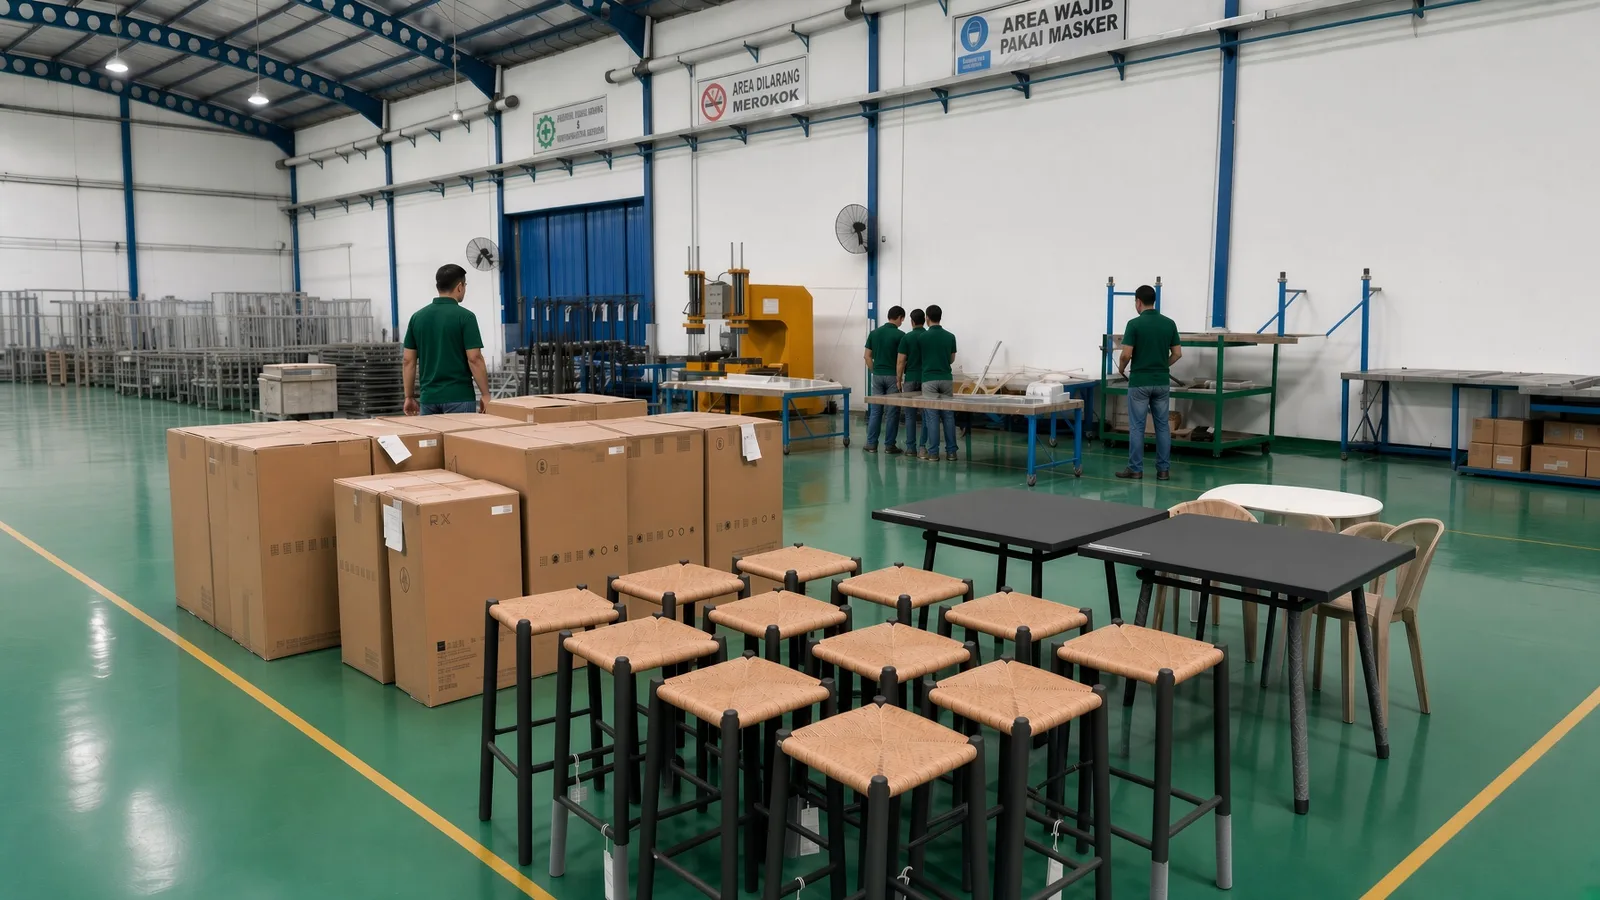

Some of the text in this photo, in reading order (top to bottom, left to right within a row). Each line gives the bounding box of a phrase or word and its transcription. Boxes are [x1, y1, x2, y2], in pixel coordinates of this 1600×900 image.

[1002, 0, 1113, 34] AREA WAJIB
[1000, 14, 1118, 55] PAKAI MASKER
[732, 68, 800, 96] AREA DILARANG
[733, 88, 800, 113] MEROKOK
